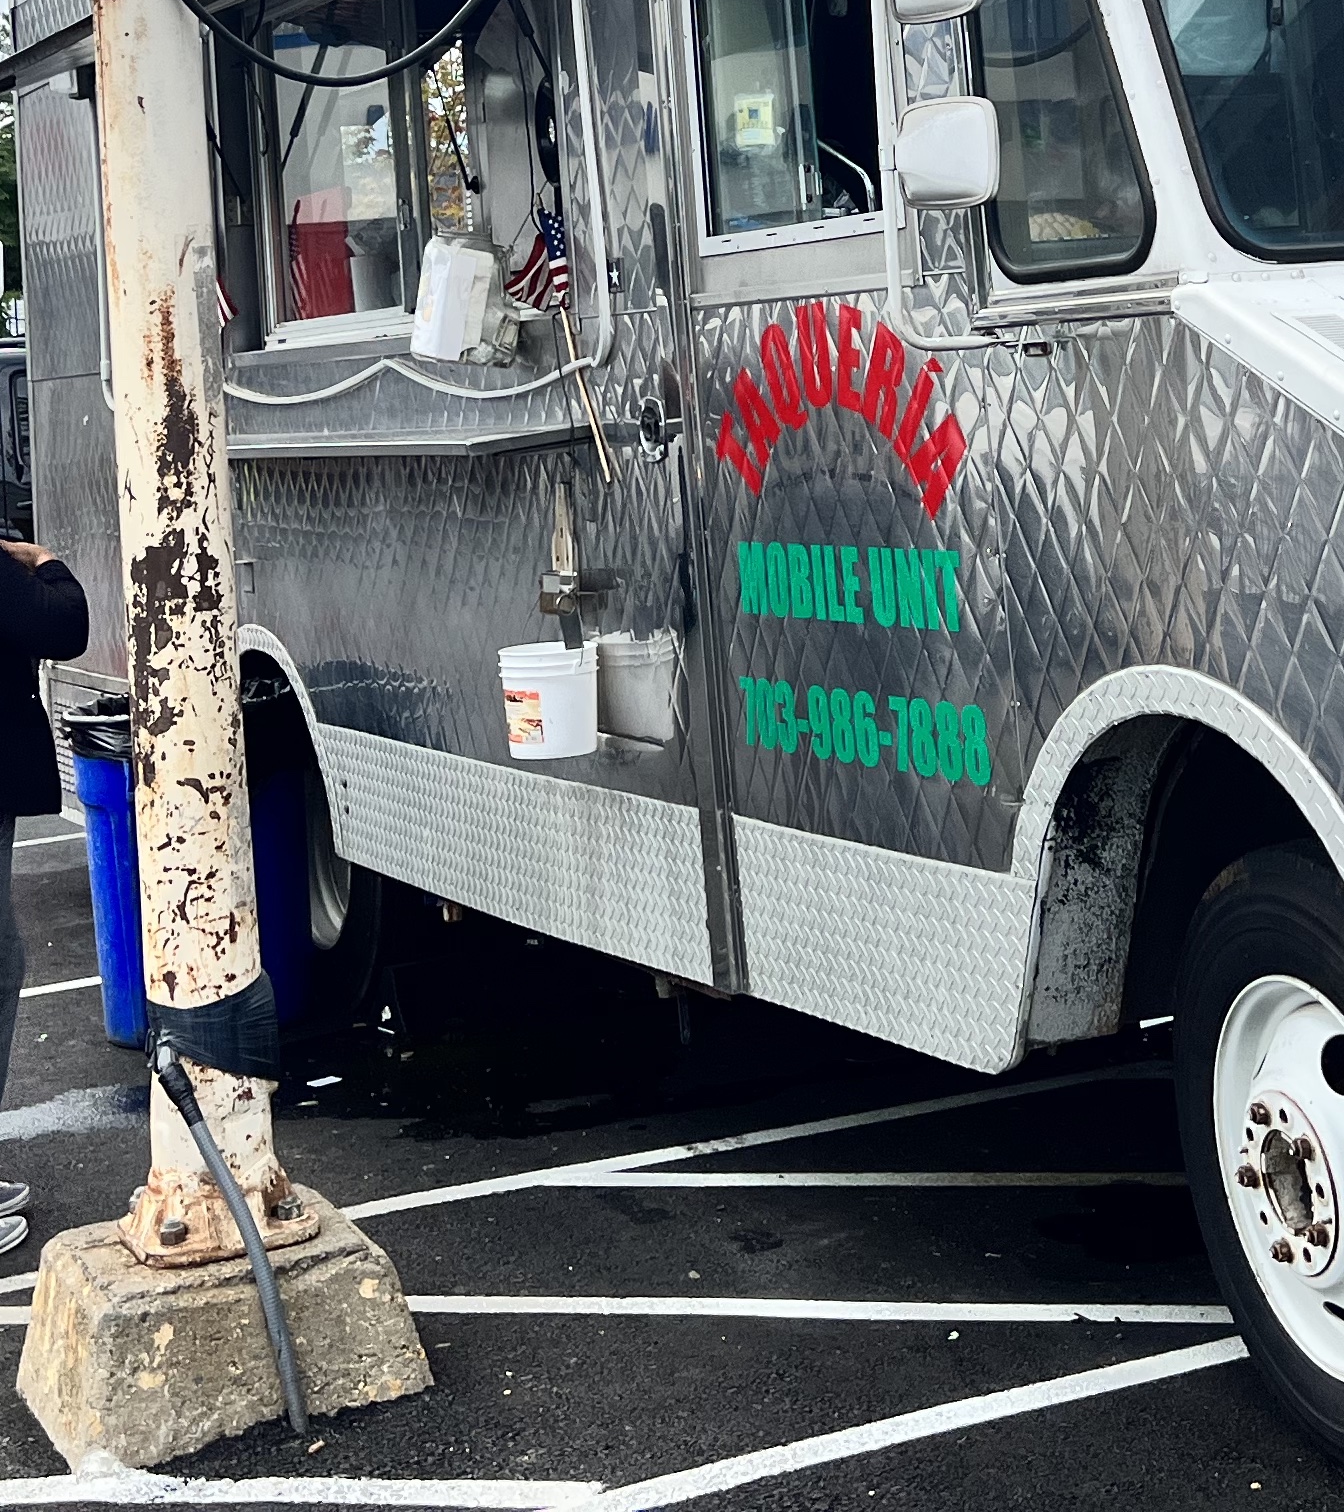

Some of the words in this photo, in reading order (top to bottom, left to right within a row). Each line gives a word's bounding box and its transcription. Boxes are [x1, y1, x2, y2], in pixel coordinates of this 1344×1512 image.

[716, 301, 968, 521] TAQUERÍA
[738, 540, 864, 625] MOBILE
[868, 546, 961, 632] UNIT
[738, 675, 993, 786] 703-986-7888
